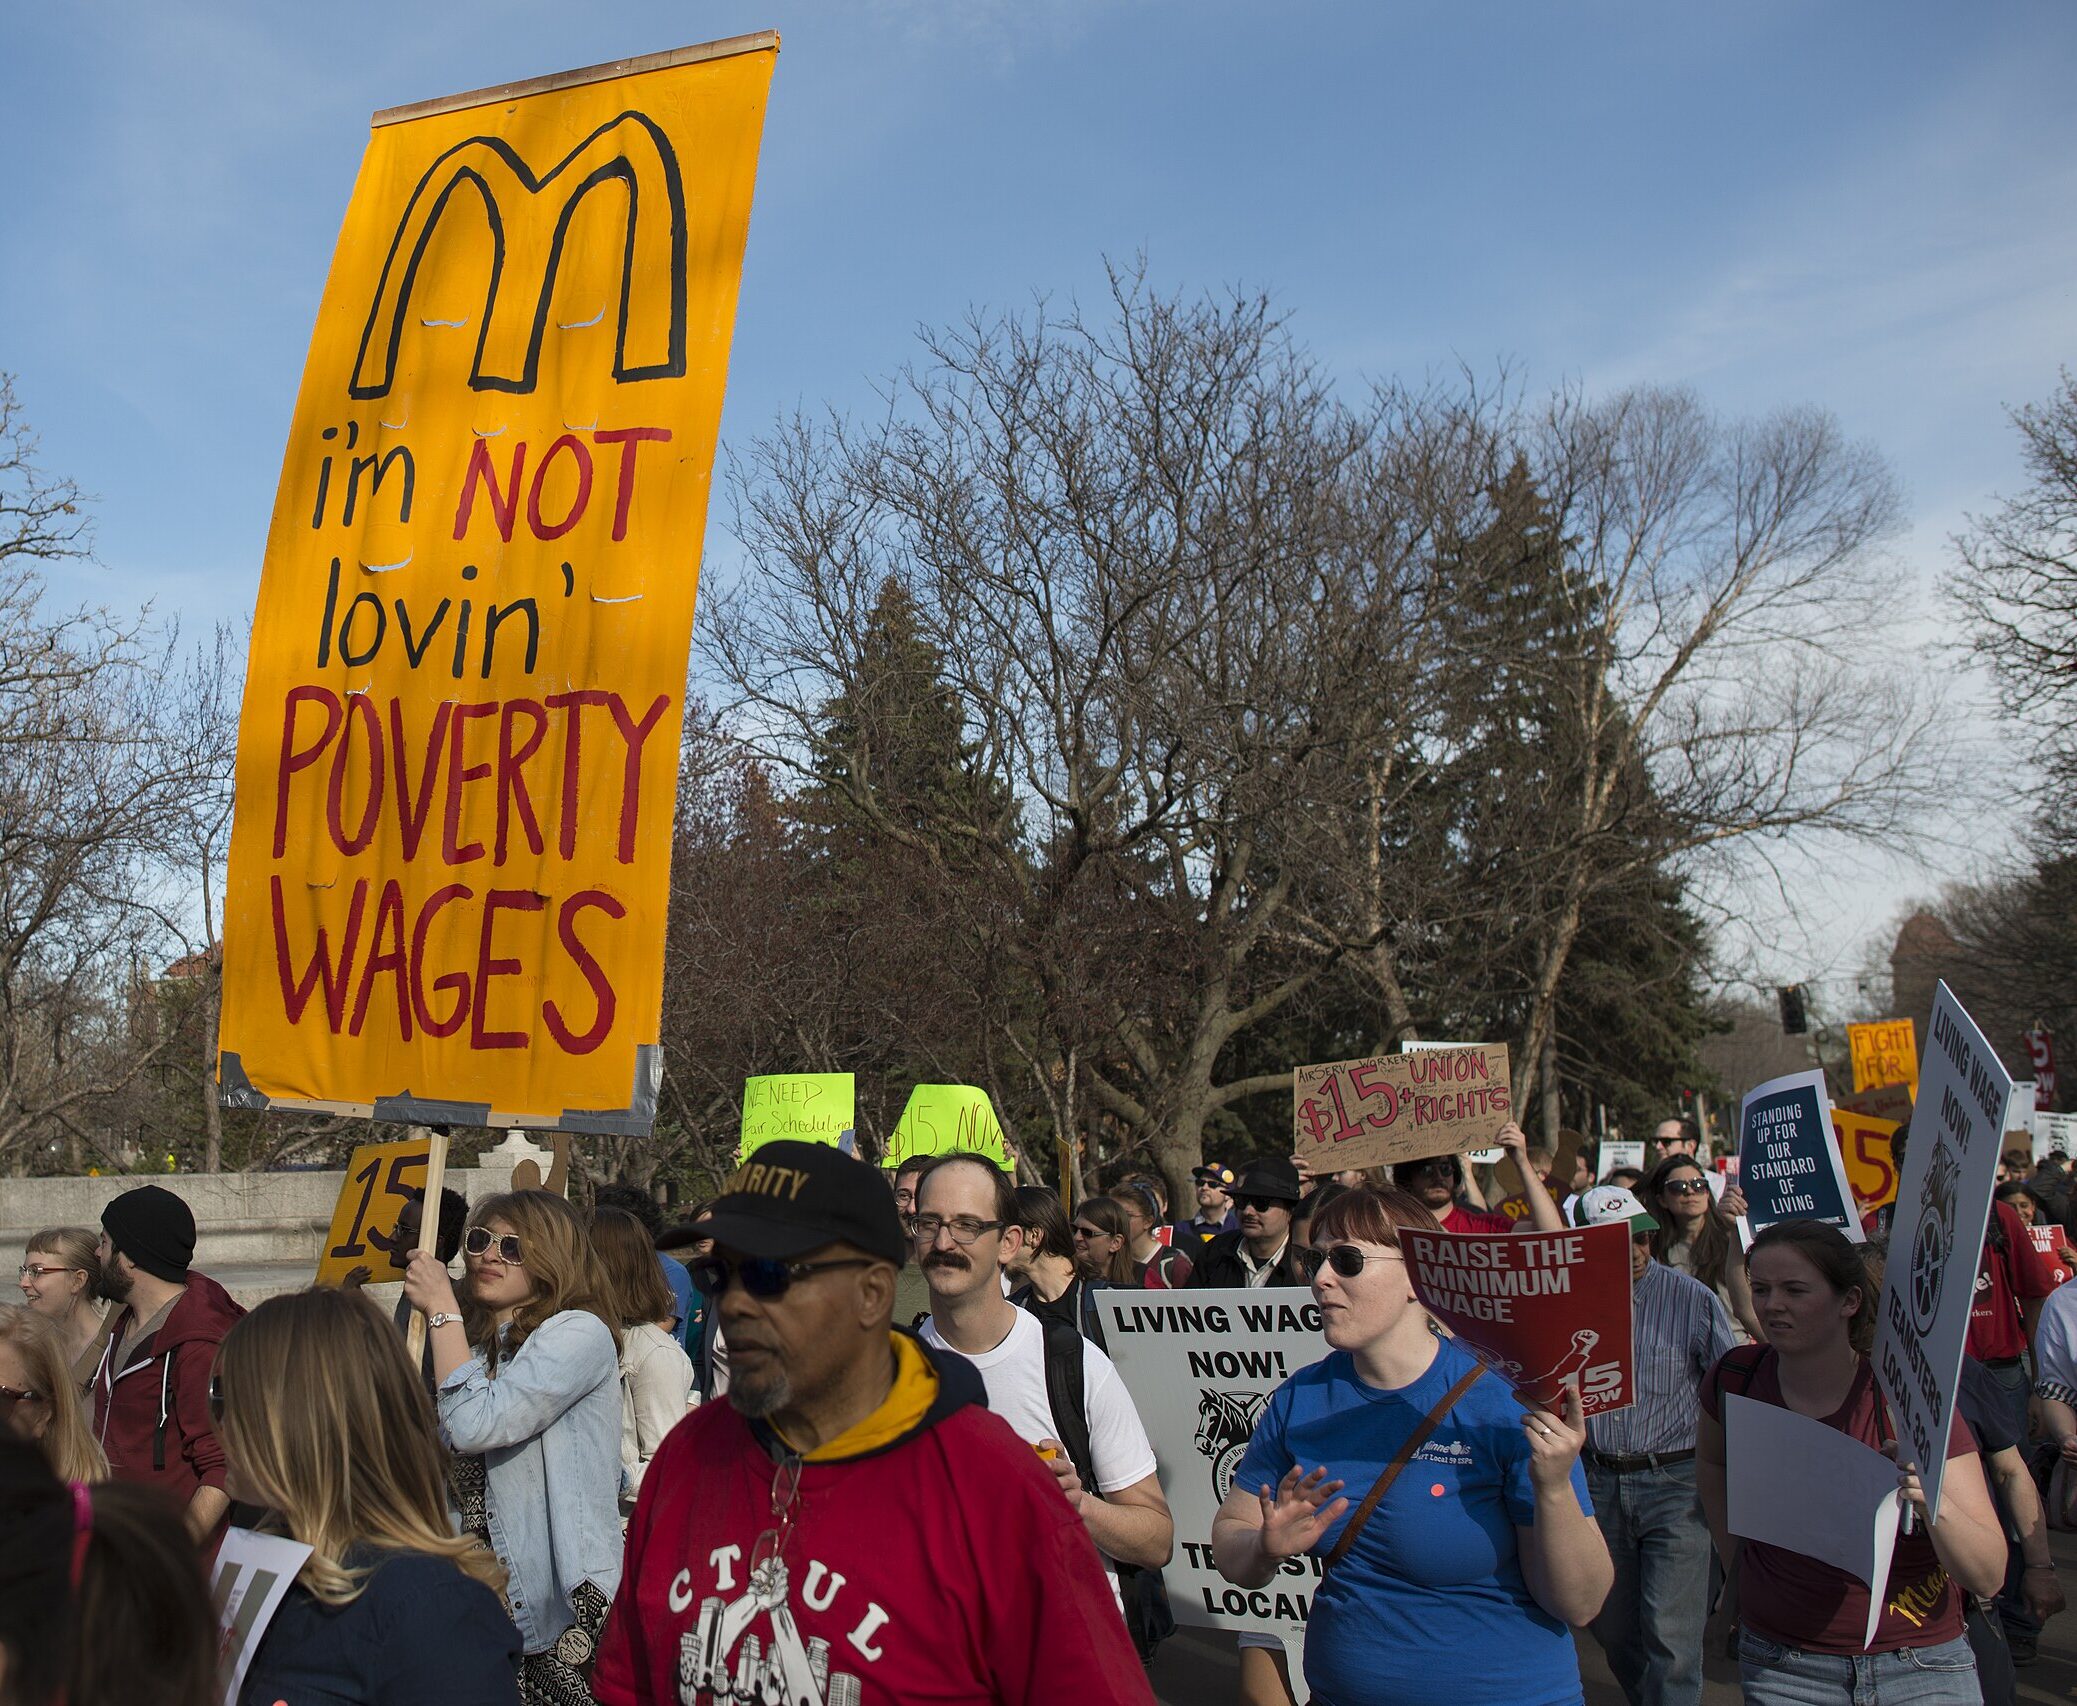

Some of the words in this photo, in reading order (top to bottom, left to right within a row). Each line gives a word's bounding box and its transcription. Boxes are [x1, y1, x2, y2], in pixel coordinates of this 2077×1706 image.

[311, 420, 415, 530] i'm
[452, 427, 673, 544] NOT
[317, 556, 576, 679] lovin'
[272, 685, 671, 866] POVERTY
[270, 874, 627, 1056] WAGES
[1853, 1026, 1911, 1053] FIGHT
[1298, 1063, 1347, 1084] AIRSERV
[1358, 1053, 1415, 1070] WORKERS
[1409, 1051, 1489, 1084] UNION
[1866, 1054, 1906, 1078] FOR
[1934, 1005, 1970, 1080] LIVING
[1969, 1053, 2001, 1131] WAGE
[769, 1081, 823, 1110] NEED
[1297, 1065, 1399, 1143] $15
[1414, 1086, 1510, 1126] RIGHTS
[1751, 1103, 1802, 1129] STANDING
[1757, 1127, 1770, 1143] UP
[1775, 1122, 1798, 1141] FOR
[1941, 1083, 1972, 1155] NOW!
[1767, 1142, 1791, 1160] OUR
[1751, 1157, 1816, 1180] STANDARD
[1779, 1178, 1795, 1195] OF
[331, 1154, 429, 1258] 15
[1771, 1194, 1815, 1215] LIVING
[1412, 1236, 1511, 1269] RAISE
[1518, 1235, 1585, 1267] THE
[1417, 1262, 1571, 1296] MINIMUM
[1113, 1305, 1231, 1334] LIVING
[1236, 1304, 1325, 1334] WAG
[1421, 1284, 1515, 1324] WAGE
[1187, 1351, 1288, 1379] NOW!
[1888, 1284, 1943, 1428] TEAMSTERS
[1882, 1340, 1912, 1430] LOCAL
[1912, 1412, 1932, 1475] 320
